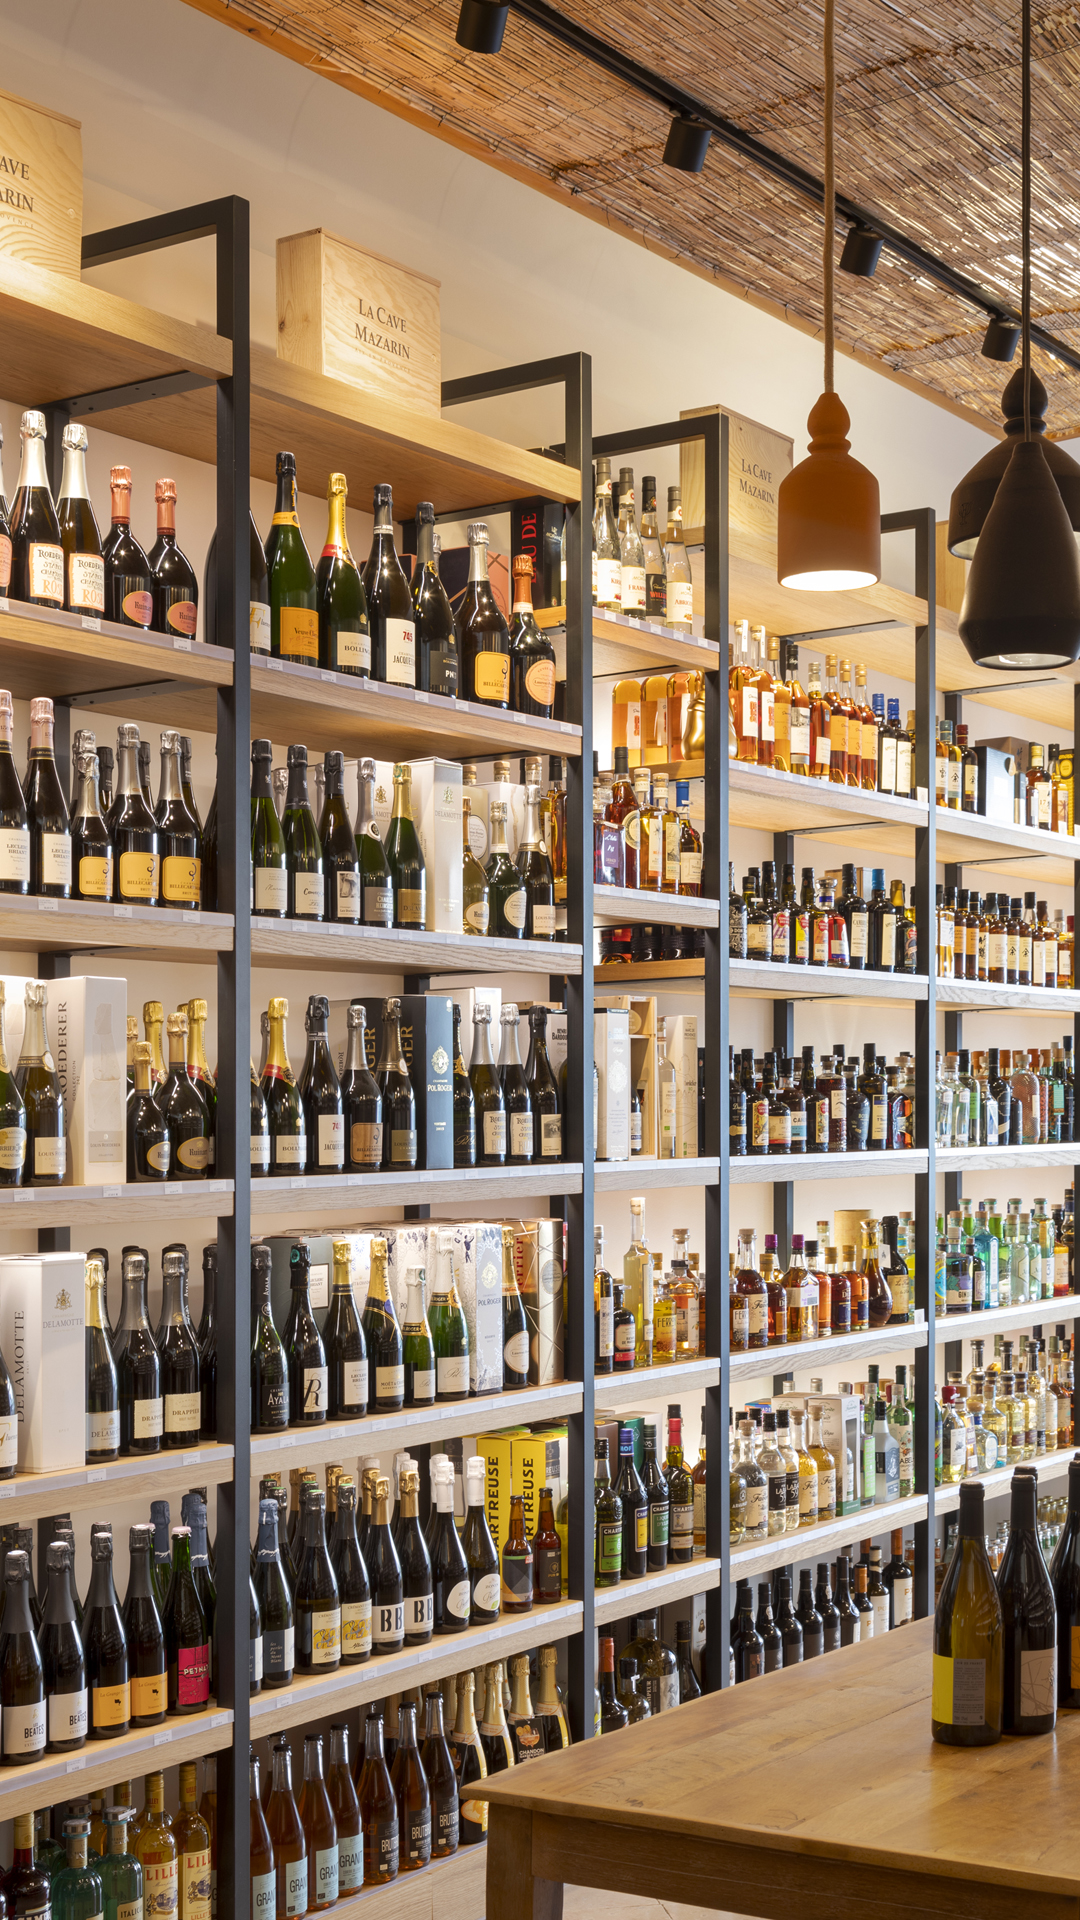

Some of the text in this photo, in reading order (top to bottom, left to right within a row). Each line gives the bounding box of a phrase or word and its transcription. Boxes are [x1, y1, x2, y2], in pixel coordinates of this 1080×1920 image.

[358, 298, 406, 333] LA CAVE
[355, 323, 410, 359] MAZARIN
[742, 458, 772, 484] LA CAVE
[739, 478, 775, 504] MAZARIN
[522, 512, 537, 541] DE
[435, 810, 462, 819] DELAMOTTE
[42, 1318, 84, 1328] DELAMOTTE
[14, 1310, 25, 1423] DELAMOTTE
[24, 1723, 44, 1739] BEATES
[519, 1747, 545, 1756] CHANDON
